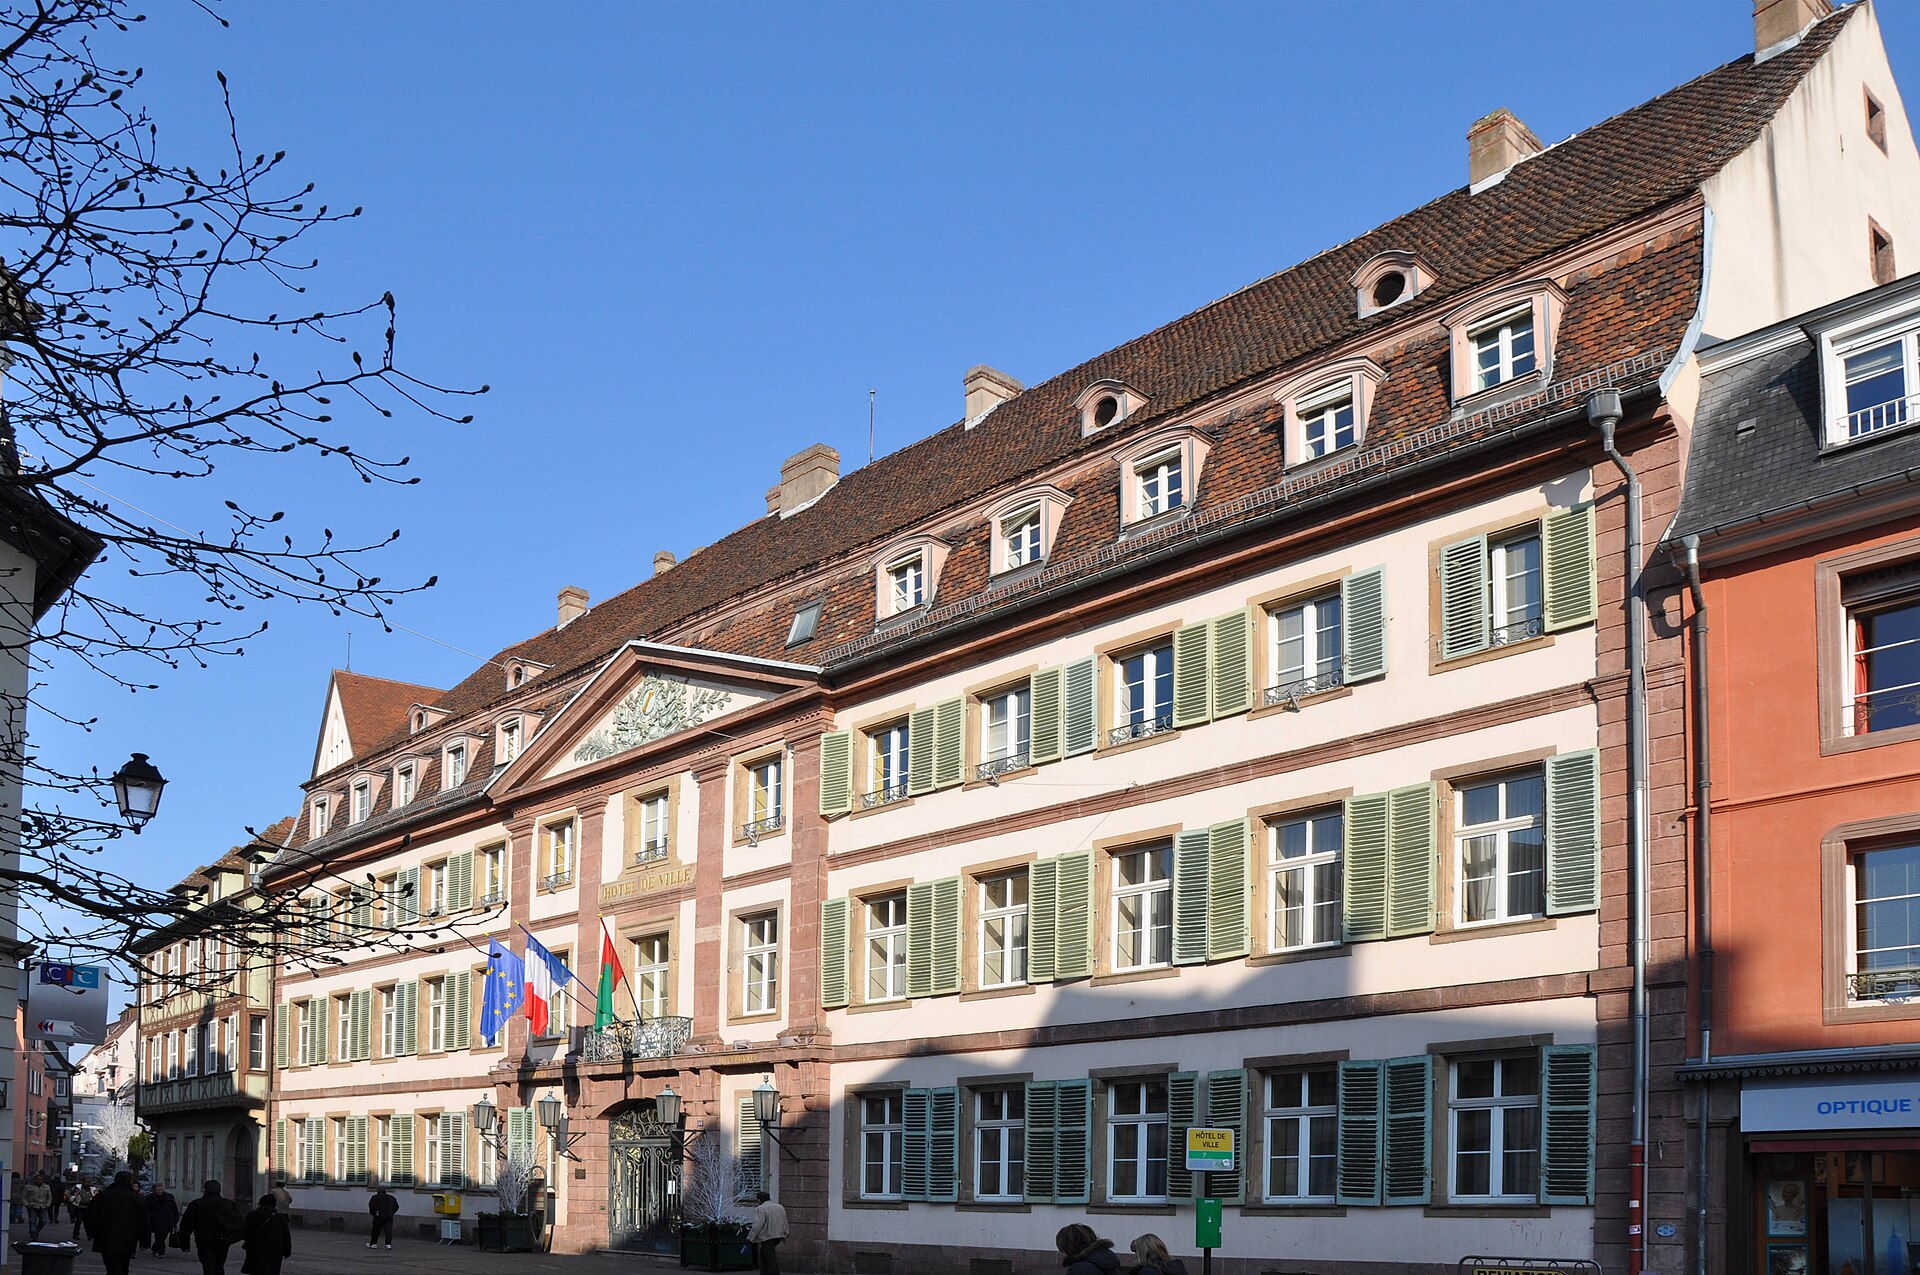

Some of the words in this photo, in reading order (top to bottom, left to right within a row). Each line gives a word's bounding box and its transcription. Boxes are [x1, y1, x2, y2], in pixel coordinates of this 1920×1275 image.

[640, 877, 655, 892] DE
[659, 868, 691, 886] VILLE
[46, 967, 93, 984] CIC
[1817, 1099, 1912, 1115] OPTIQUE
[1195, 1131, 1216, 1140] HÔTEL
